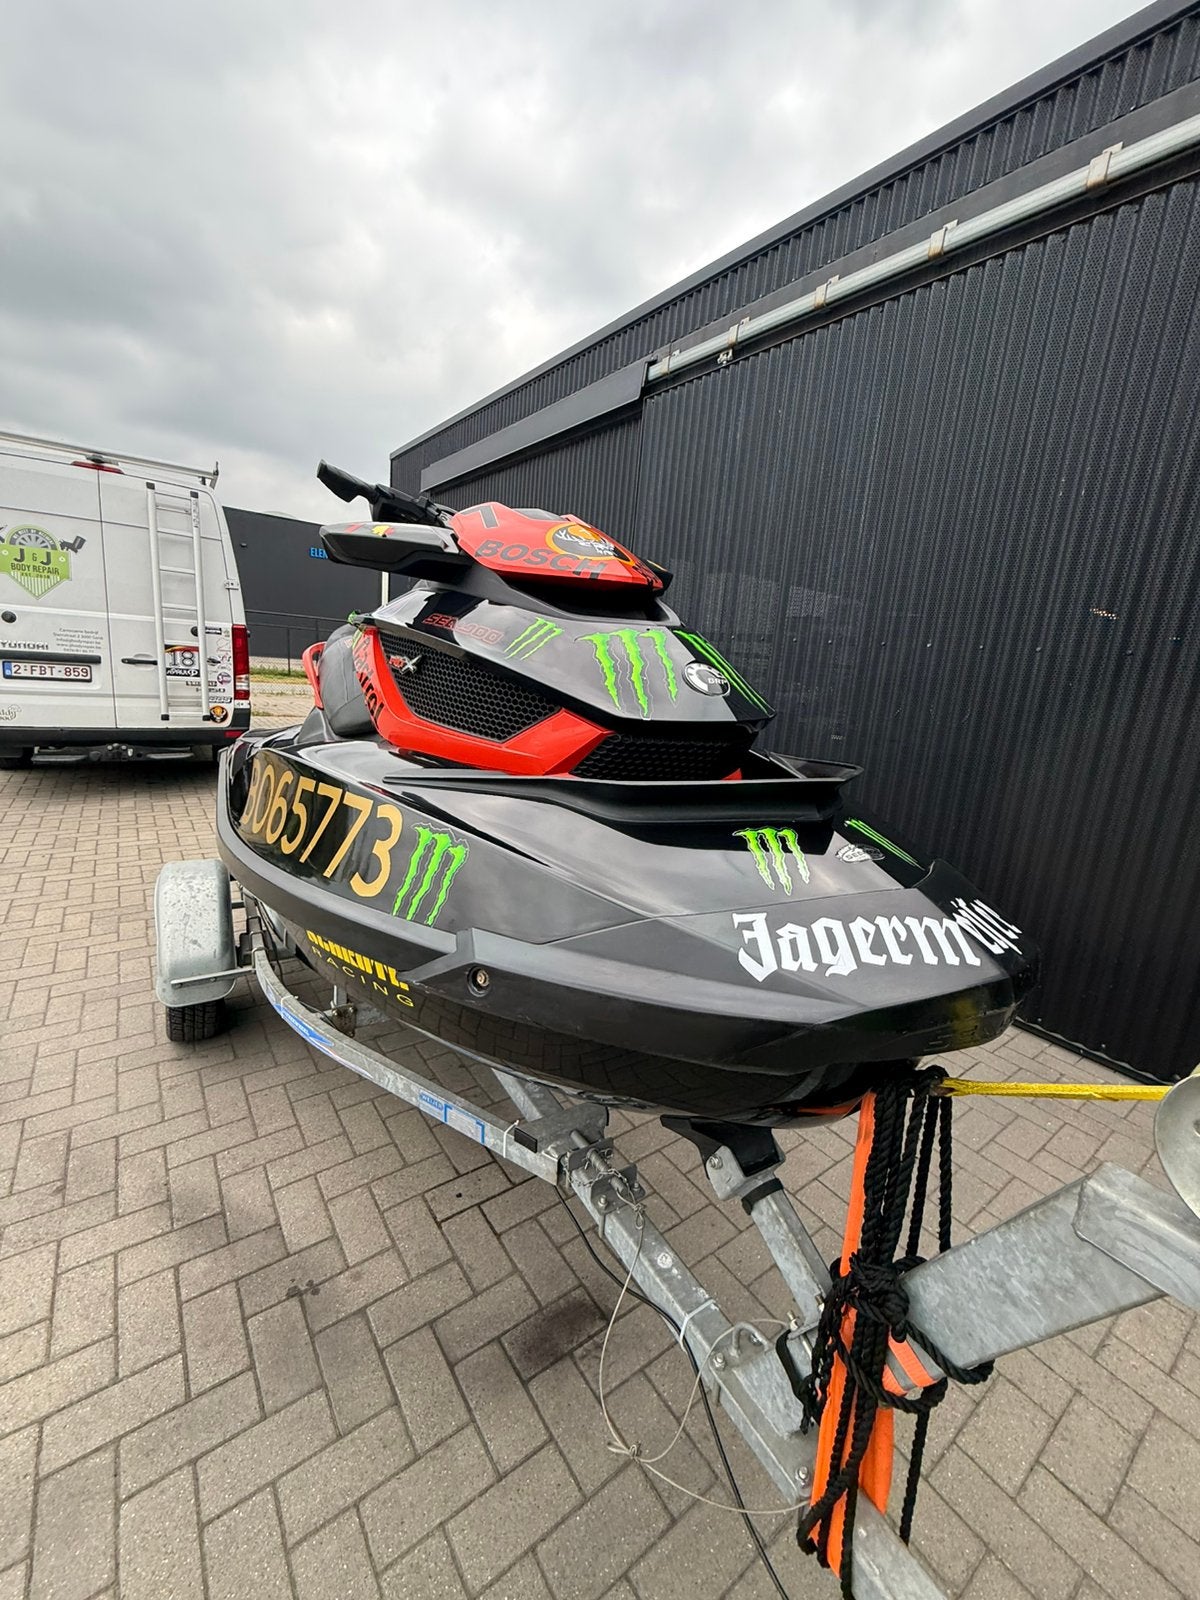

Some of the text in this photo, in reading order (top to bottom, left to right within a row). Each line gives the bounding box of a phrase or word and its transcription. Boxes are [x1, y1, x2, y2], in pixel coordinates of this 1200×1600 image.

[13, 548, 25, 563] J
[40, 551, 52, 566] J
[475, 540, 608, 581] BOSCH
[11, 562, 60, 576] BODY REPAIR
[168, 650, 195, 667] 18
[311, 945, 415, 1007] RACING
